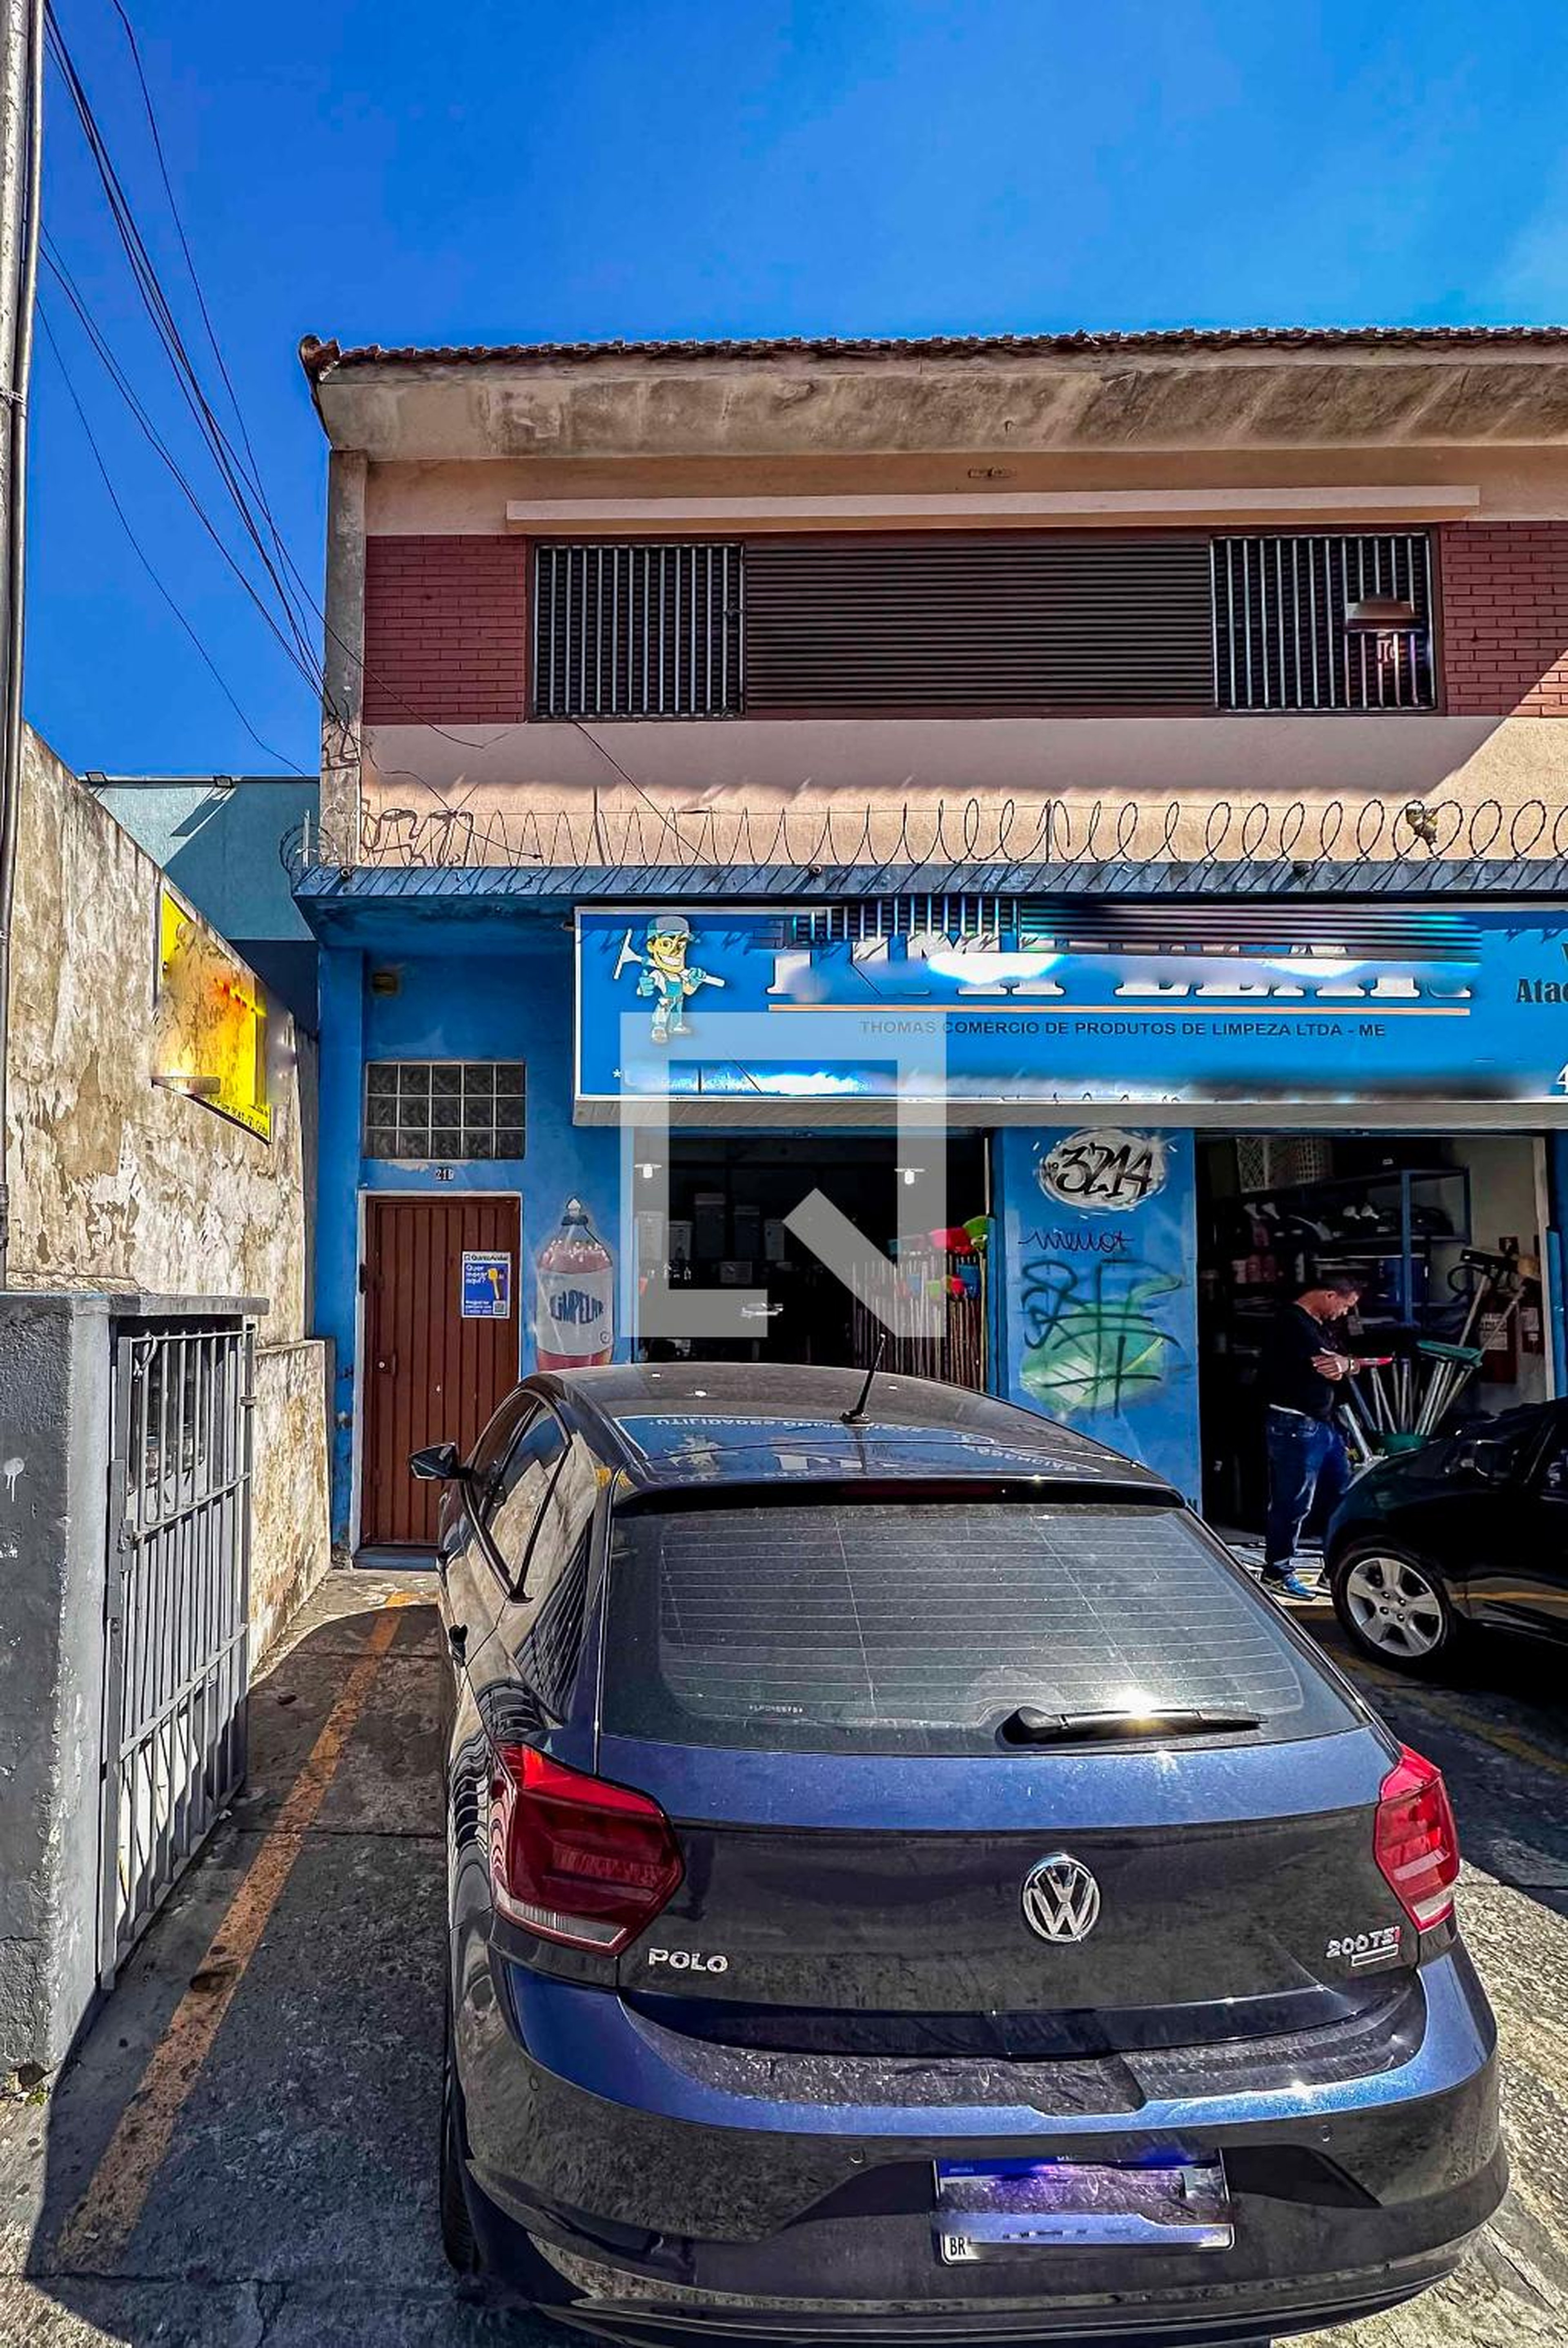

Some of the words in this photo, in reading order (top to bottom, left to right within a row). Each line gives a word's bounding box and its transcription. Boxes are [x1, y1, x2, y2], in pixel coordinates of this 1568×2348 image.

[862, 1021, 936, 1034] THOMAS
[943, 1022, 1039, 1035] COMERCIO
[1045, 1023, 1067, 1035] DE
[1076, 1023, 1176, 1036] PRODUTOS
[1181, 1023, 1205, 1035] DE
[1212, 1023, 1291, 1036] LIMPEZA
[1296, 1023, 1342, 1037] LTDA
[1359, 1024, 1385, 1037] ME
[648, 1948, 728, 1973] POLO
[949, 2237, 966, 2256] BR
